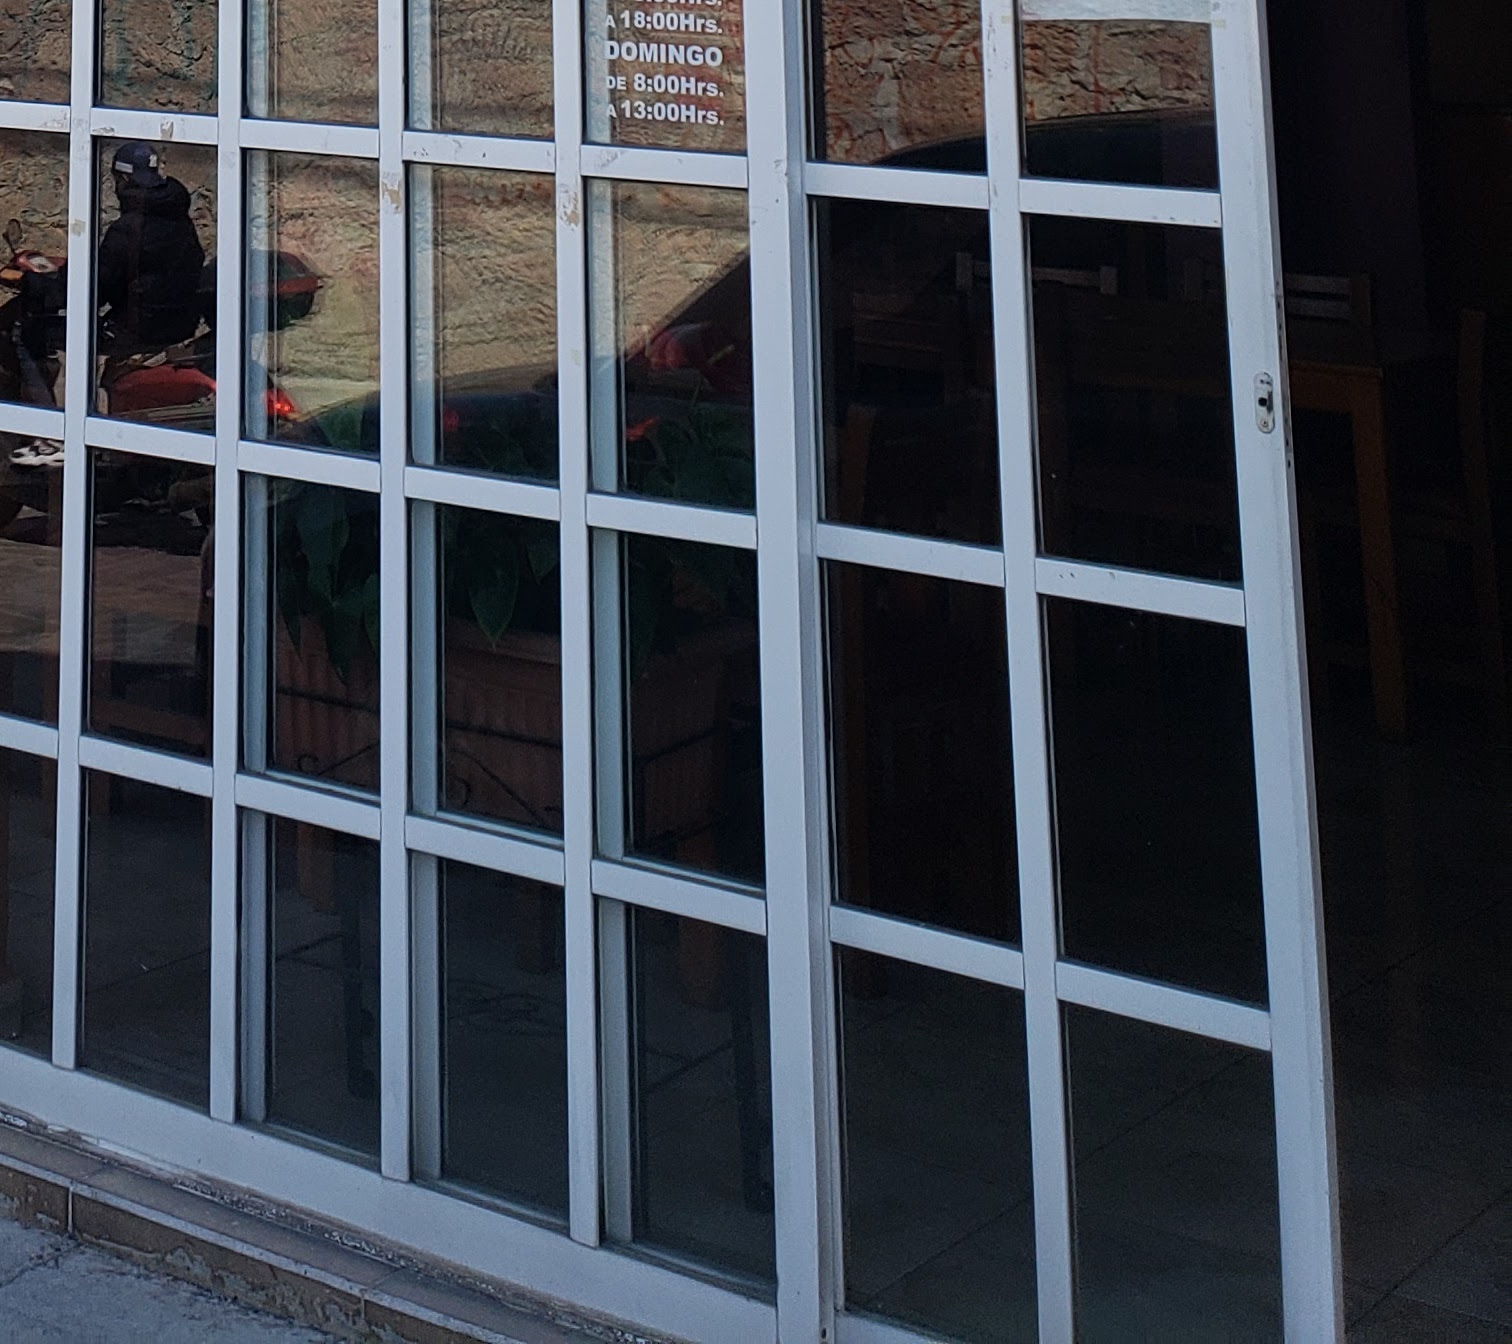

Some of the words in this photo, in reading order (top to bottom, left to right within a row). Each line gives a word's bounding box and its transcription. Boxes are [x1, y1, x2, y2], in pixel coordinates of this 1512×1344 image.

[605, 14, 617, 29] A
[620, 9, 723, 34] 18:00Hrs.
[604, 40, 724, 67] DOMINGO
[605, 75, 628, 91] DE
[633, 72, 725, 98] 8:00Hrs.
[606, 103, 618, 119] A
[621, 99, 725, 126] 13:00Hrs.
